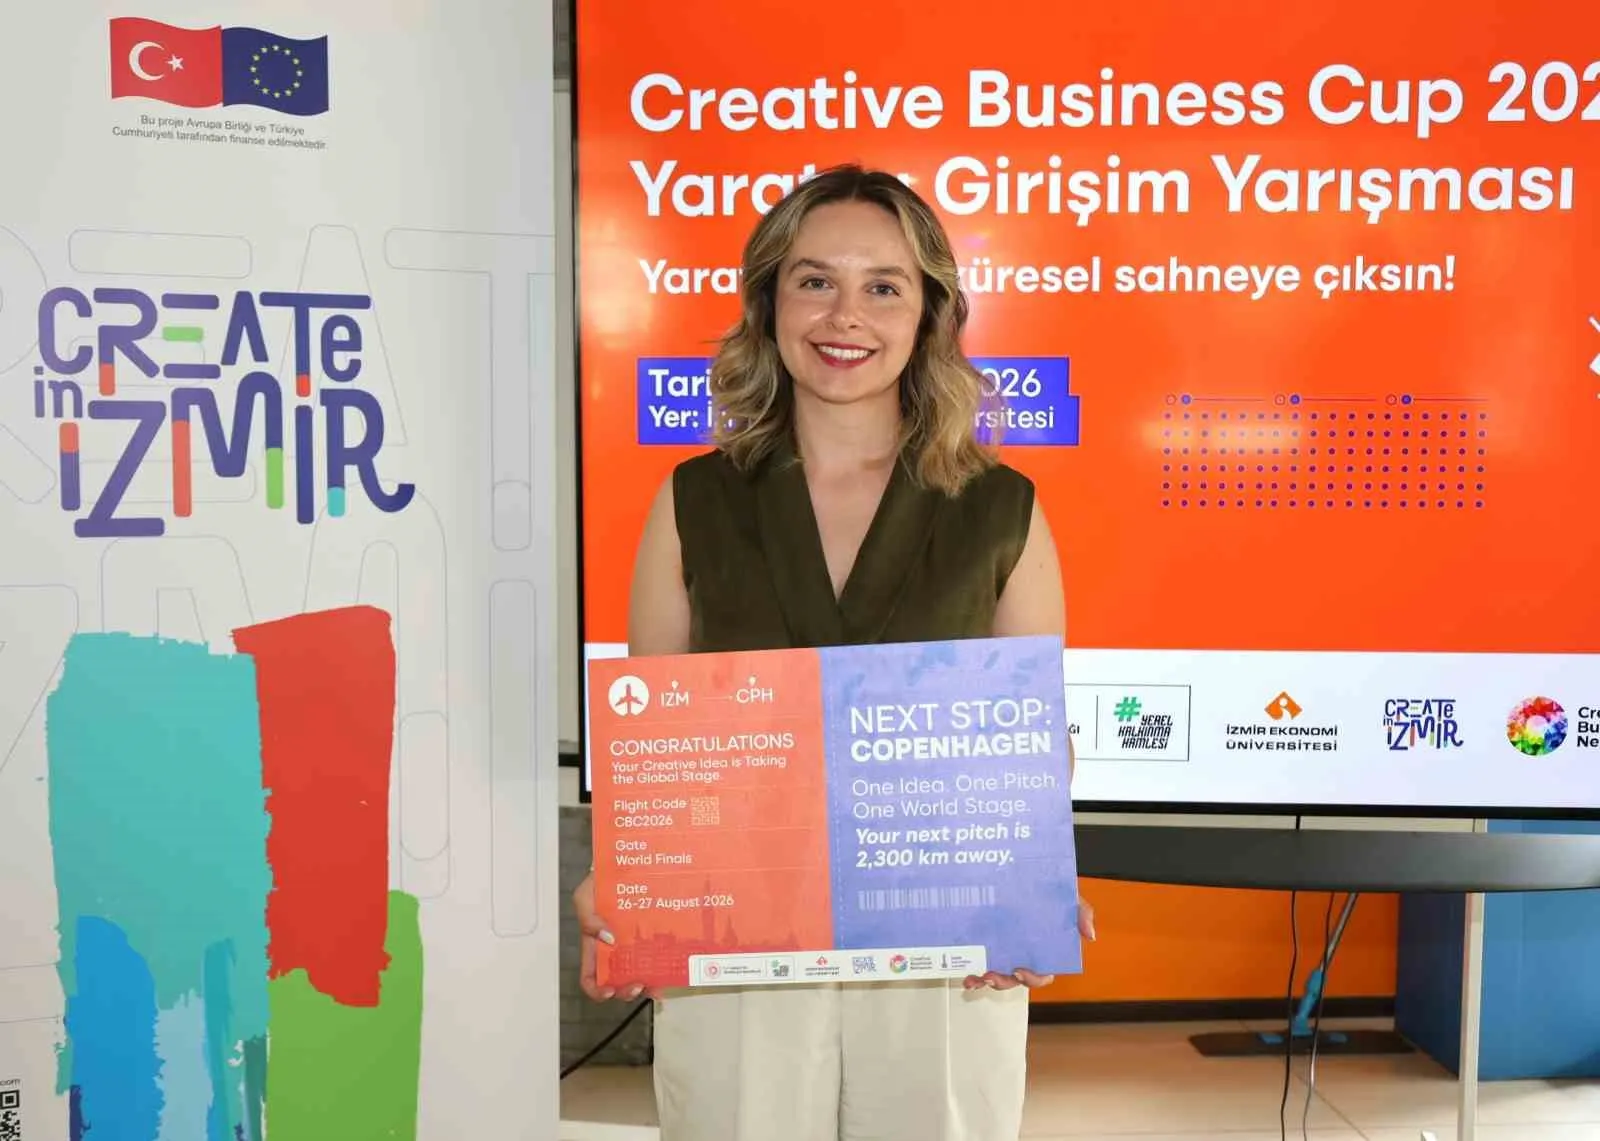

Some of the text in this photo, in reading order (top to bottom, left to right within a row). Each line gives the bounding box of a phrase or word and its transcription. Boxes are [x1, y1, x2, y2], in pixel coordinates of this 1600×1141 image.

[630, 60, 1600, 138] Creative Business Cup 202
[112, 126, 174, 141] Cumhuriyeti
[229, 134, 265, 145] finanse
[140, 114, 155, 125] Bu
[158, 118, 184, 129] proje
[186, 117, 222, 129] Avrupa
[253, 124, 266, 133] ve
[269, 123, 305, 136] Türkiye
[934, 155, 1191, 226] Girişim
[1211, 154, 1575, 225] Yarışması
[1114, 257, 1301, 300] sahneye
[1314, 256, 1455, 299] çıksın!
[648, 368, 1042, 398] Tari 026
[648, 405, 699, 428] Yer:
[975, 406, 1054, 429] rsitesi
[661, 688, 773, 707] IZM CPH
[851, 698, 1052, 734] NEXT STOP:
[609, 733, 795, 757] CONGRATULATIONS
[850, 731, 1052, 762] COPENHAGEN
[612, 754, 787, 773] Your Creative Idea is Taking
[612, 773, 634, 784] the
[636, 771, 679, 784] Global
[852, 779, 894, 797] One
[955, 774, 998, 792] One
[613, 798, 687, 814] Flight Code
[853, 802, 895, 819] One
[901, 798, 959, 817] World
[614, 815, 673, 828] CBC2026
[856, 822, 1031, 844] Your next pitch is
[615, 840, 647, 852] Gate
[616, 852, 692, 866] World Finals
[855, 848, 1015, 869] 2,300 km away.
[616, 883, 648, 896] Date
[617, 895, 734, 910] 26-27 August 2026
